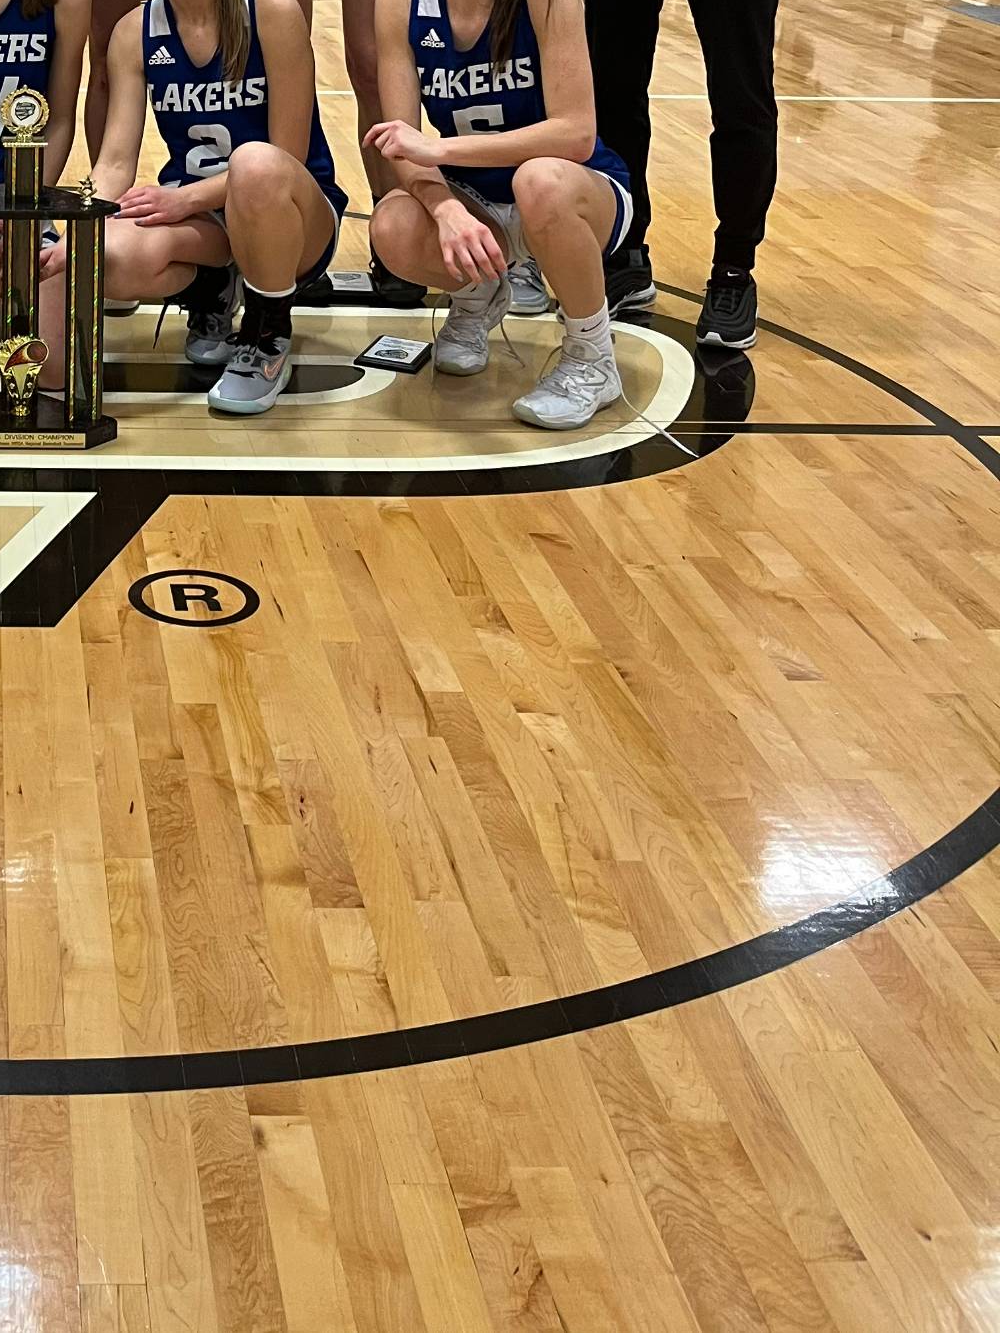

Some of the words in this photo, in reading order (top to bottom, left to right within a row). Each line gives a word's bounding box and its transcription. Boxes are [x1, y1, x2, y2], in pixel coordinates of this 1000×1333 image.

[148, 57, 176, 66] adidas
[416, 56, 535, 99] LAKERS
[146, 77, 266, 112] LAKERS
[185, 123, 233, 178] 2
[4, 433, 35, 441] DIVISION
